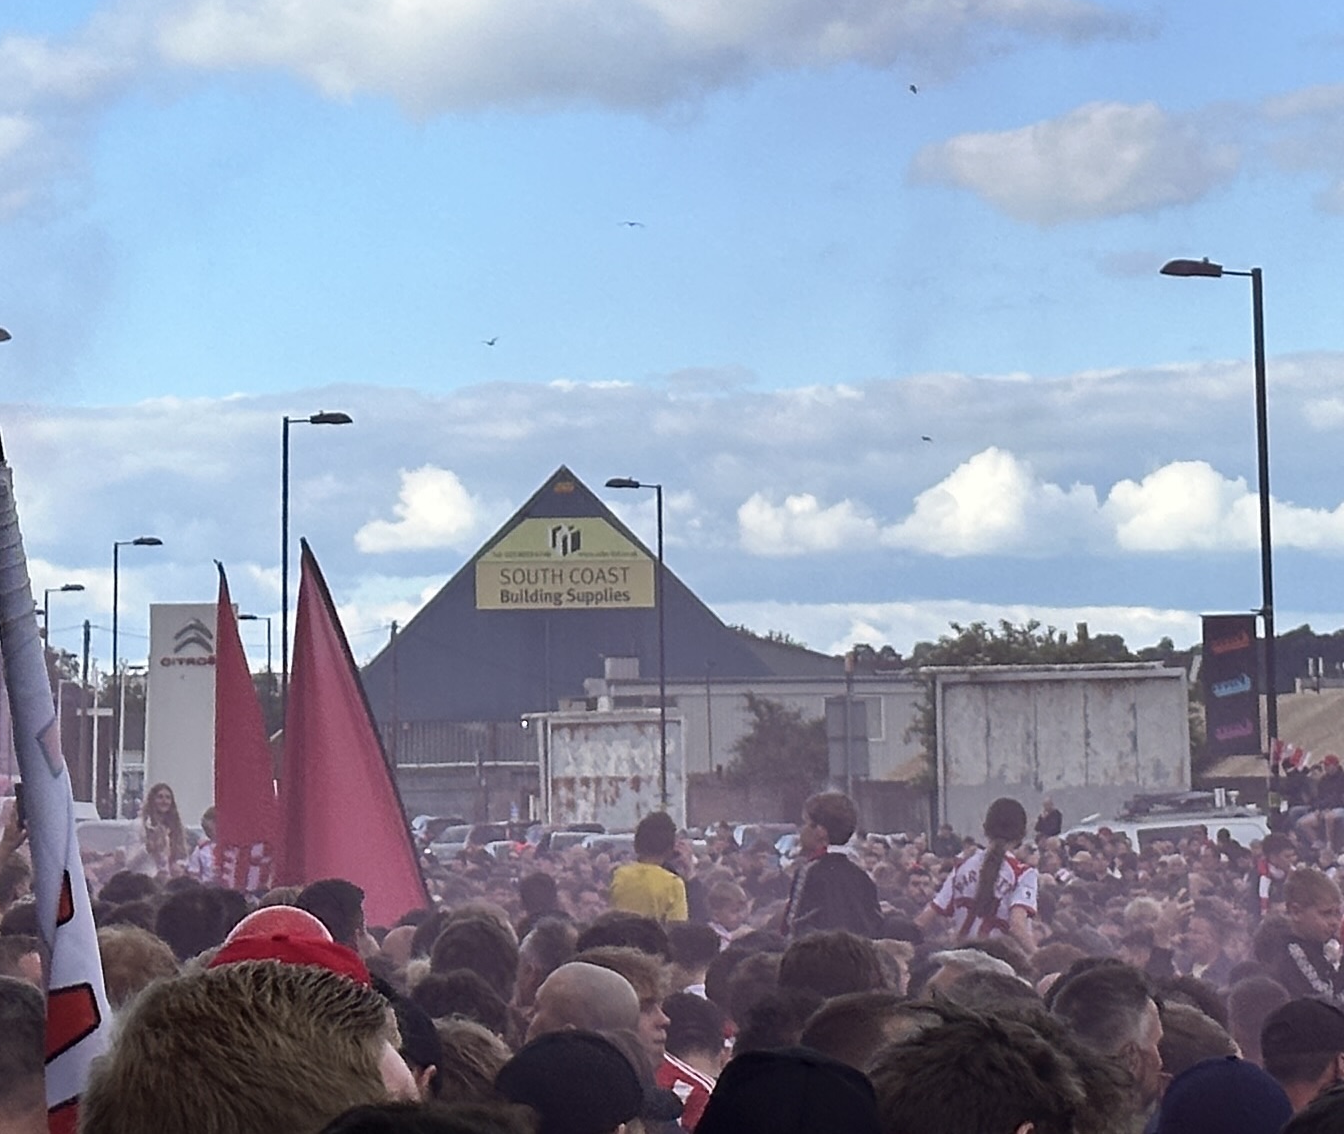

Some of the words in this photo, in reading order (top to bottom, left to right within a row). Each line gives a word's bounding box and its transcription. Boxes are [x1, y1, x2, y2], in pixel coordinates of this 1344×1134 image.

[499, 567, 563, 586] SOUTH
[569, 566, 631, 585] COAST
[500, 588, 563, 606] Building
[566, 587, 631, 606] Supplies
